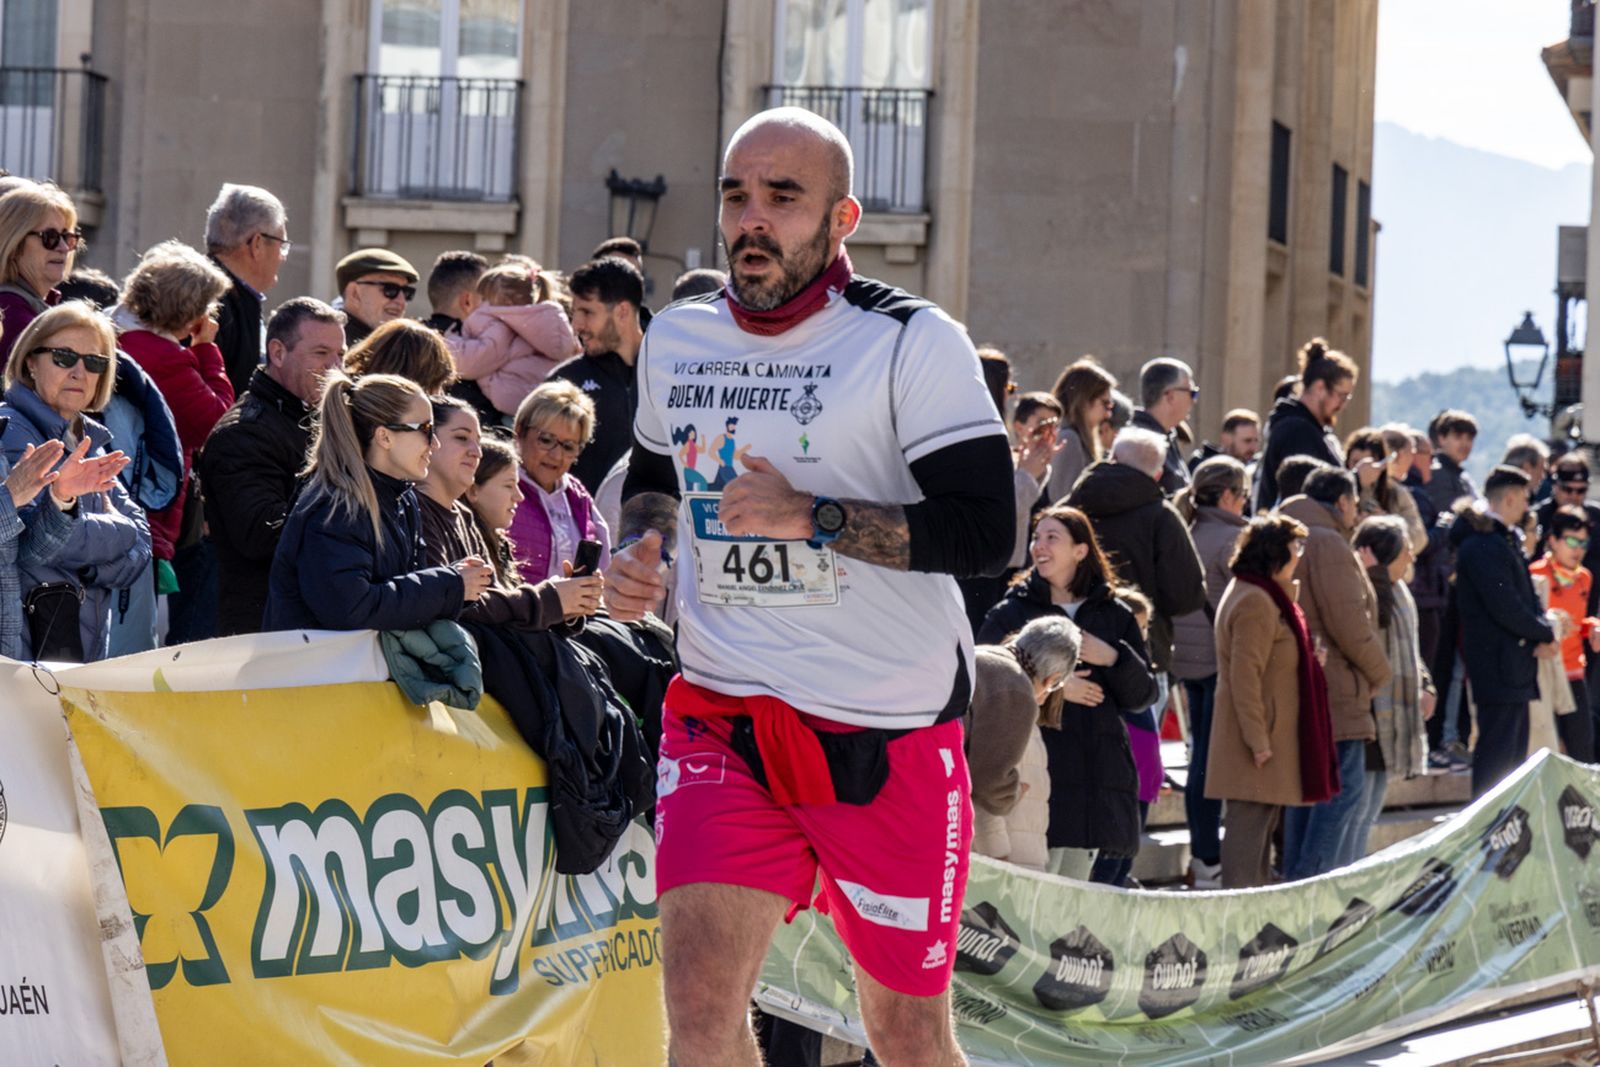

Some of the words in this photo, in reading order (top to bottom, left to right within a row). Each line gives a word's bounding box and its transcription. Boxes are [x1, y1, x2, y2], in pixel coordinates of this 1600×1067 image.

[674, 362, 687, 375] VI
[688, 361, 750, 377] CARRERA
[755, 362, 831, 378] CAMINATA
[667, 385, 714, 409] BUENA
[720, 386, 792, 411] MUERTE
[723, 544, 790, 584] 461
[940, 789, 959, 923] masymas
[957, 923, 1010, 963] wnat
[0, 976, 49, 1015] JAÉN
